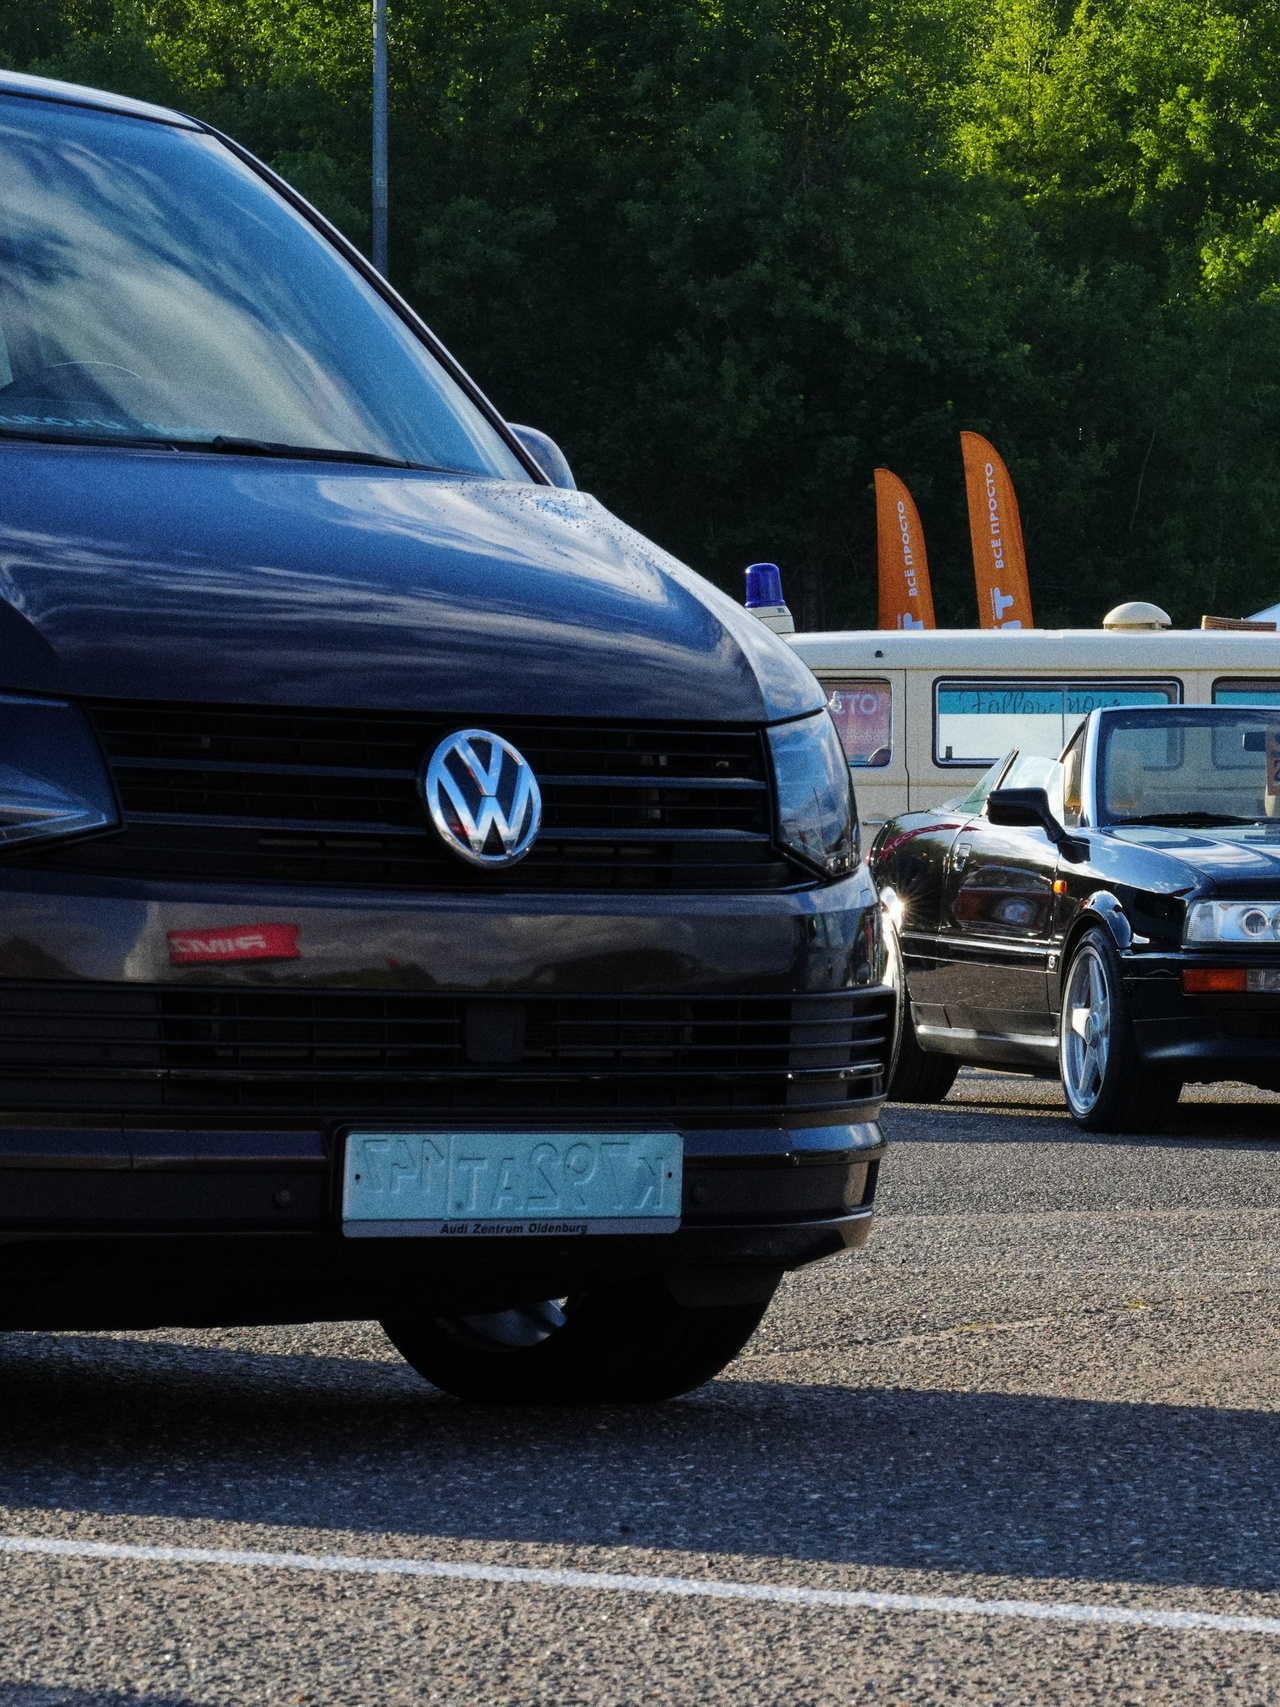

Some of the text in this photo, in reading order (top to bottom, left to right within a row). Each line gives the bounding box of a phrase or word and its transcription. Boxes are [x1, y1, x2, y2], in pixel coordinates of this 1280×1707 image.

[985, 462, 1001, 535] ПРОСТО
[897, 500, 914, 566] ПРОСТО
[440, 1222, 588, 1236] Audi Zentrum Oldenburg
